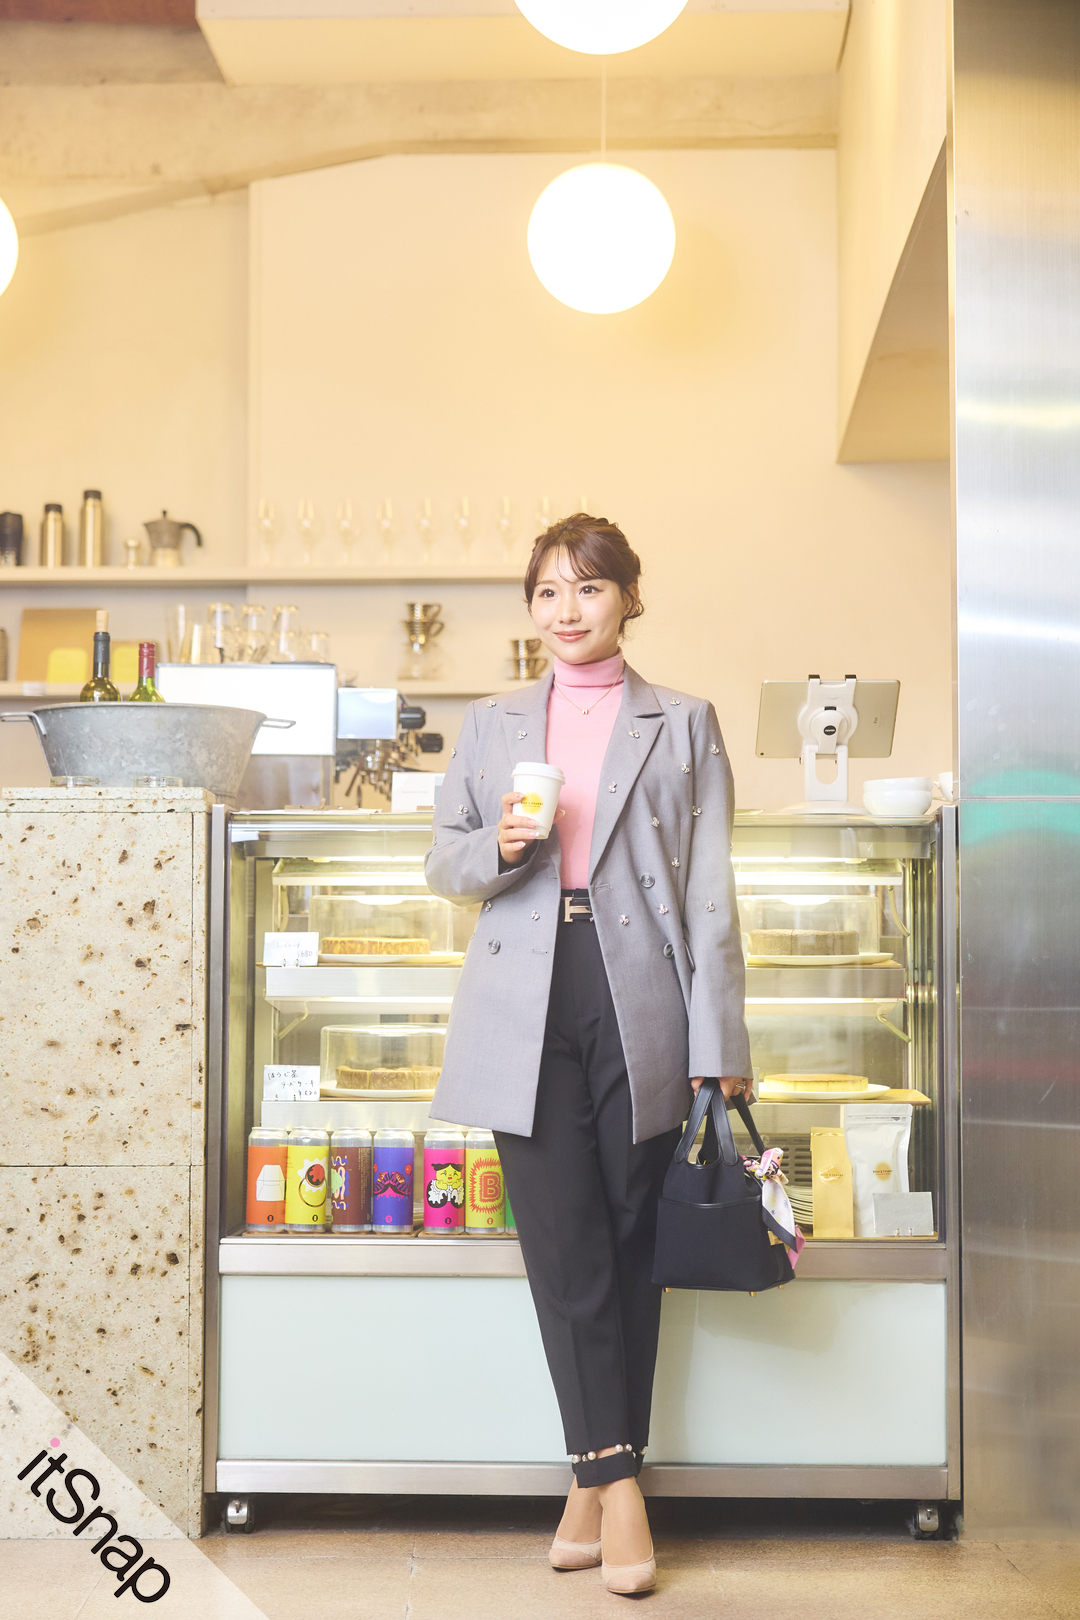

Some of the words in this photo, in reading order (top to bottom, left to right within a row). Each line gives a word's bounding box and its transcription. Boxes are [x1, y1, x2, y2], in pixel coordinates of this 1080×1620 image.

[267, 1069, 299, 1081] ほうじ茶
[480, 1172, 501, 1201] B
